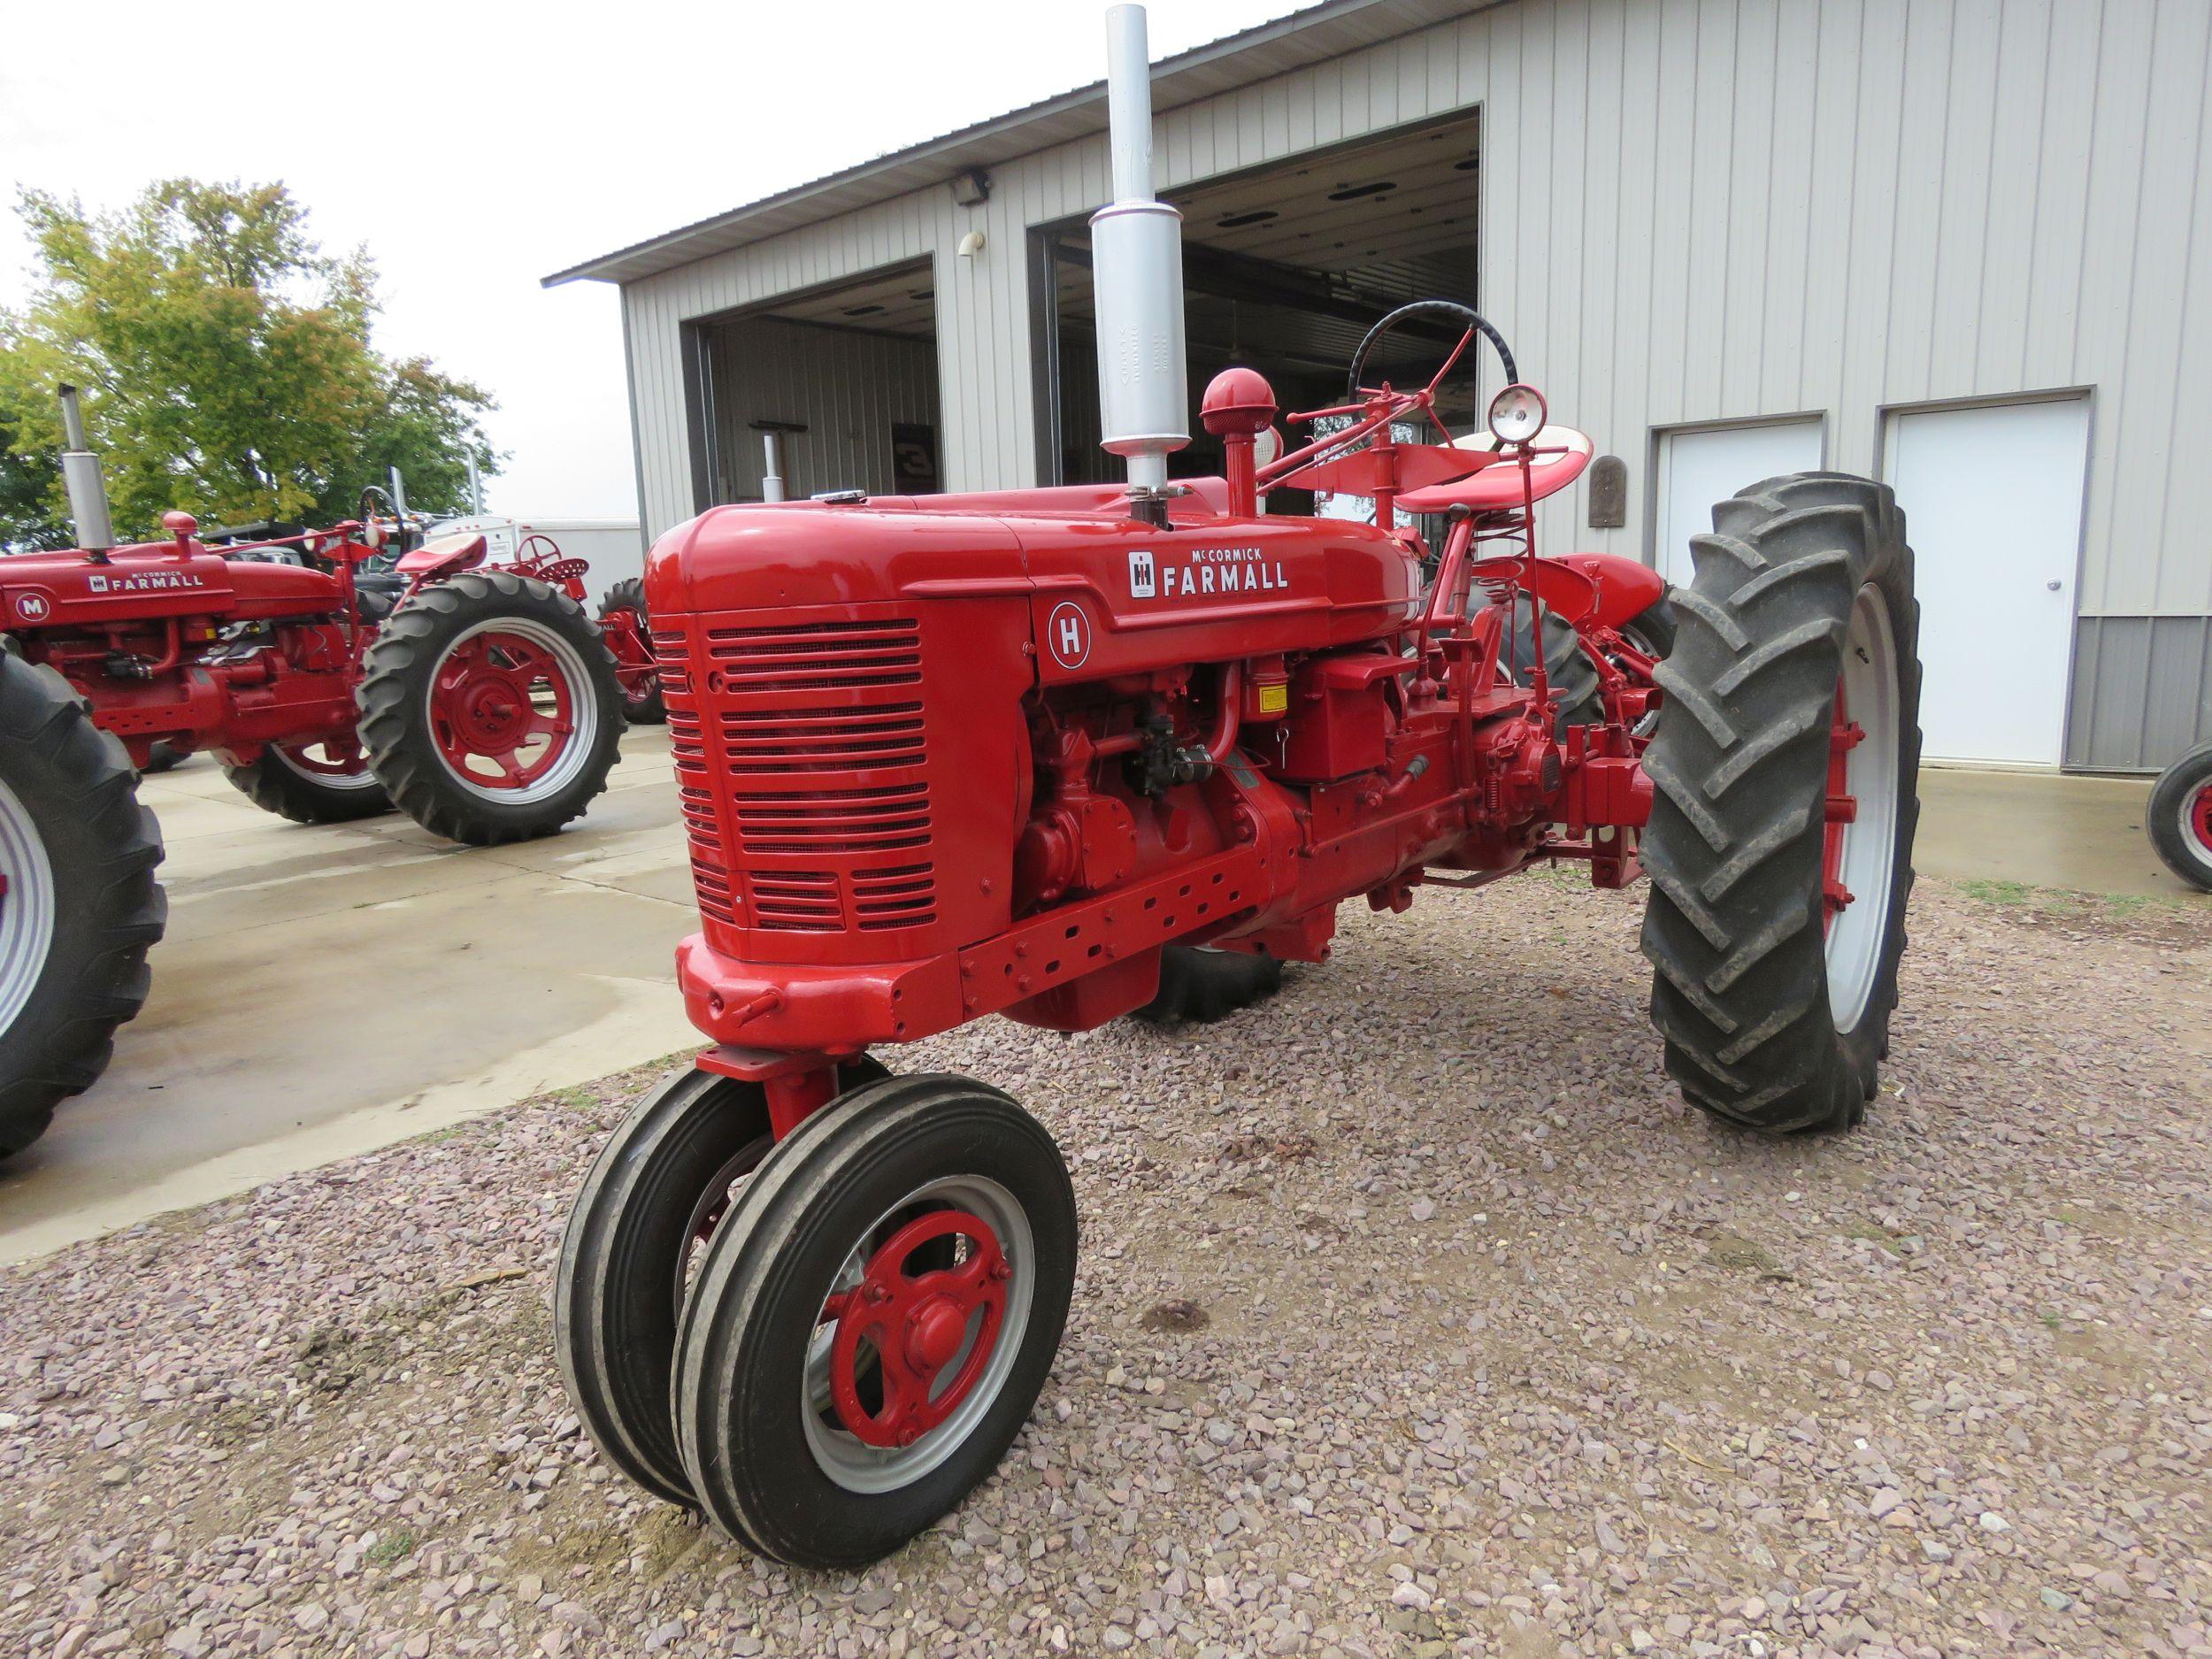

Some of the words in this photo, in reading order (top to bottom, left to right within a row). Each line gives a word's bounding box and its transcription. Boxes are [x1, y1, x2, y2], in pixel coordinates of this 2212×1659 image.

[896, 442, 934, 475] 3
[1192, 548, 1262, 564] McCORMICK
[112, 575, 204, 590] FARMALL
[1163, 562, 1288, 596] FARMALL
[22, 599, 43, 614] M
[1059, 617, 1081, 655] H
